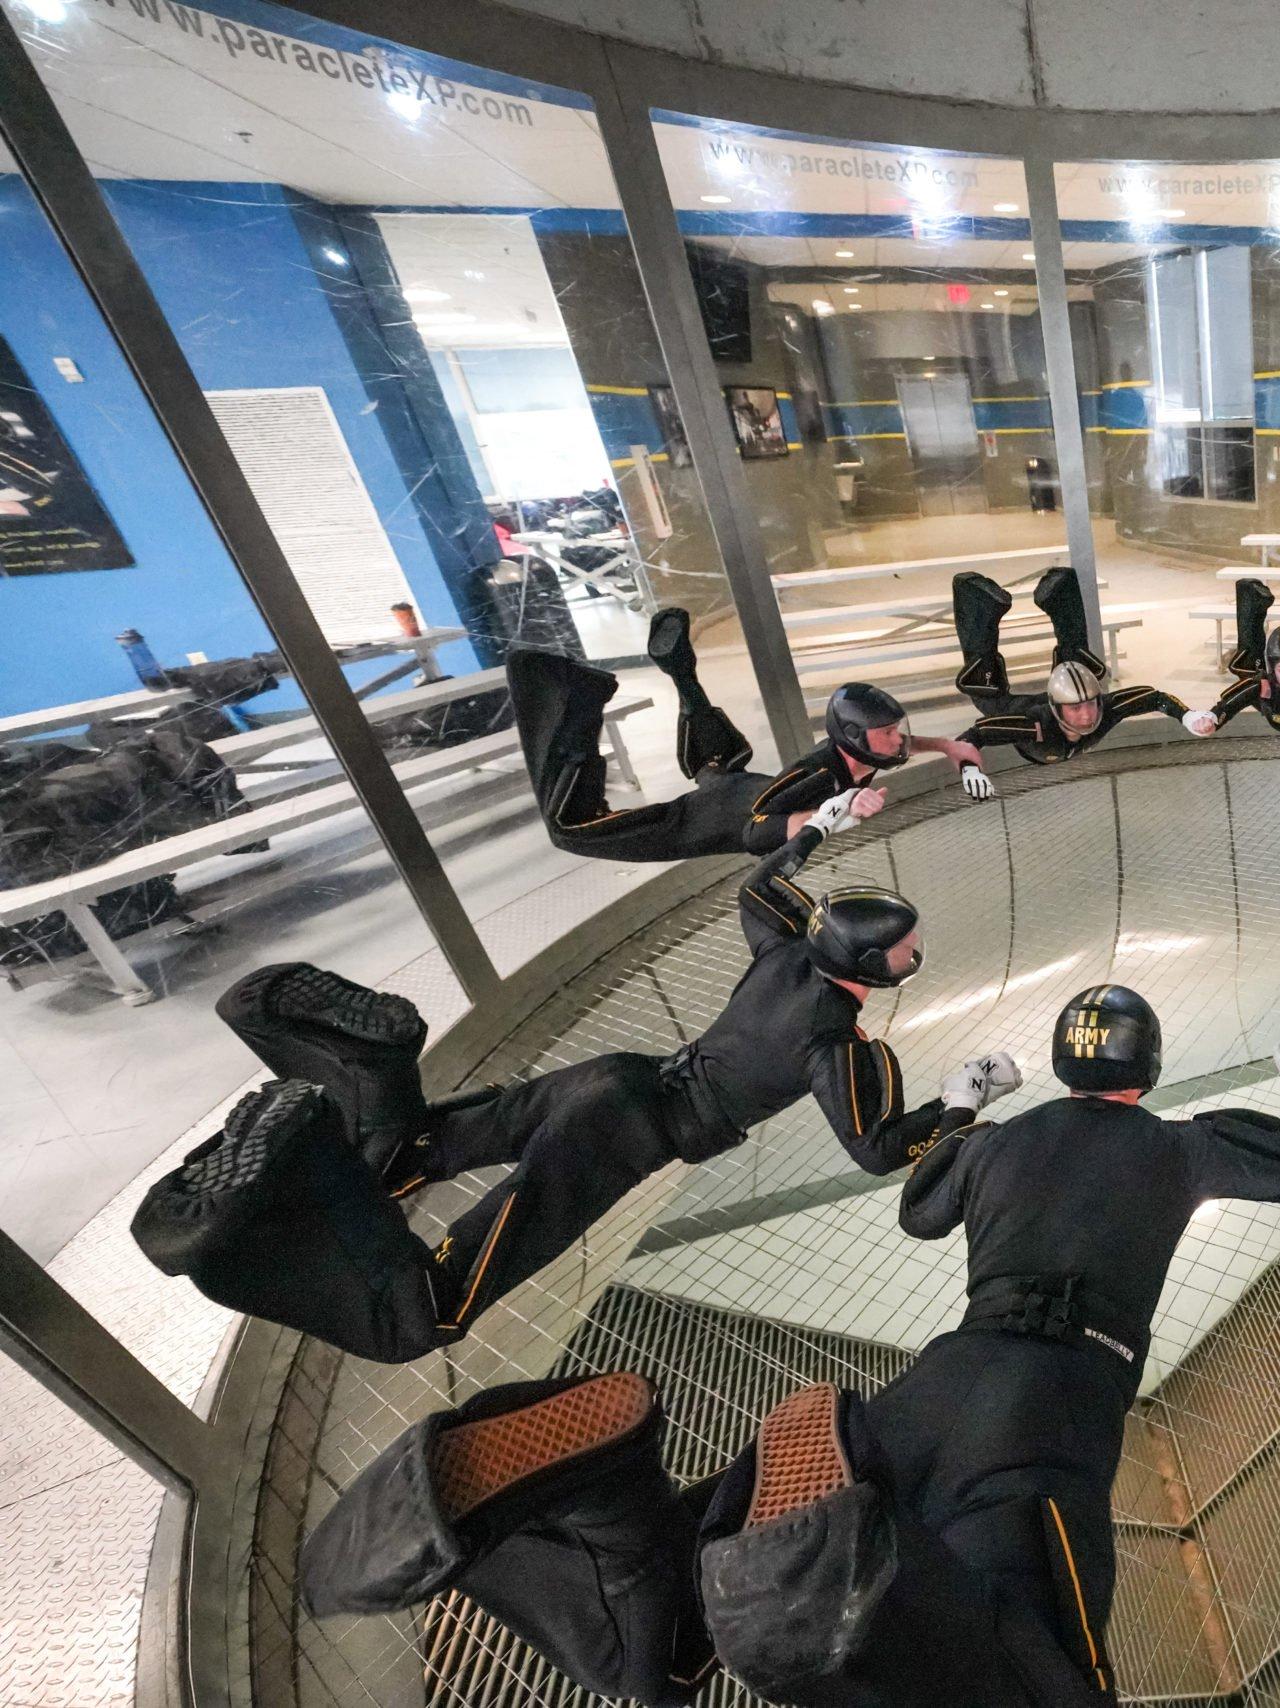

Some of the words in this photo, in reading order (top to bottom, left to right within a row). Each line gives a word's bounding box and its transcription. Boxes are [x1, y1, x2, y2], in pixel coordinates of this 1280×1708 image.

[97, 0, 534, 126] ww.paracleteXP.com
[709, 141, 979, 188] www.paracleteXPcom
[1065, 1026, 1111, 1046] ARMY
[981, 1060, 997, 1074] N
[971, 1078, 984, 1091] N
